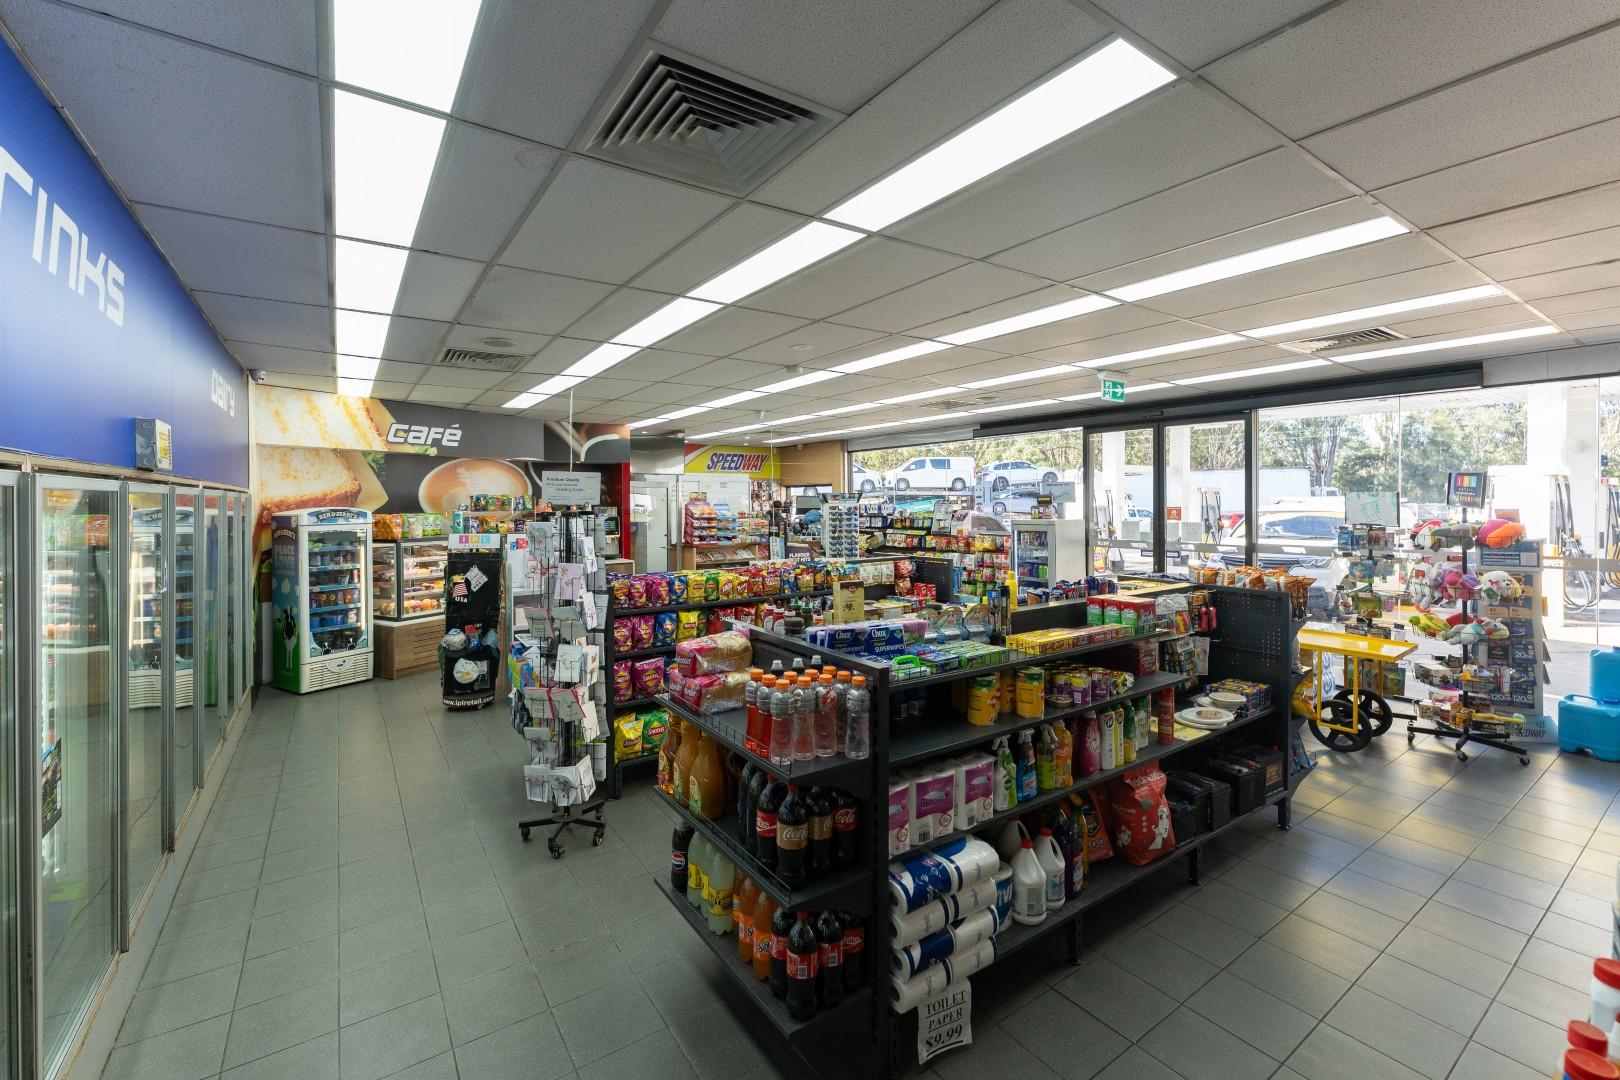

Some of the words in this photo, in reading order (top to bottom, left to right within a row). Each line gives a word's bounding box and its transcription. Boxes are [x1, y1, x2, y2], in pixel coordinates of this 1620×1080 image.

[211, 368, 235, 417] Dairy
[707, 452, 769, 472] SPEEDWAY
[835, 631, 852, 640] Chux
[871, 629, 887, 639] Chux
[874, 643, 905, 653] SUPERWIPES
[926, 990, 966, 1015] TOILET
[928, 1007, 963, 1031] PAPER
[926, 1024, 963, 1052] $9.99
